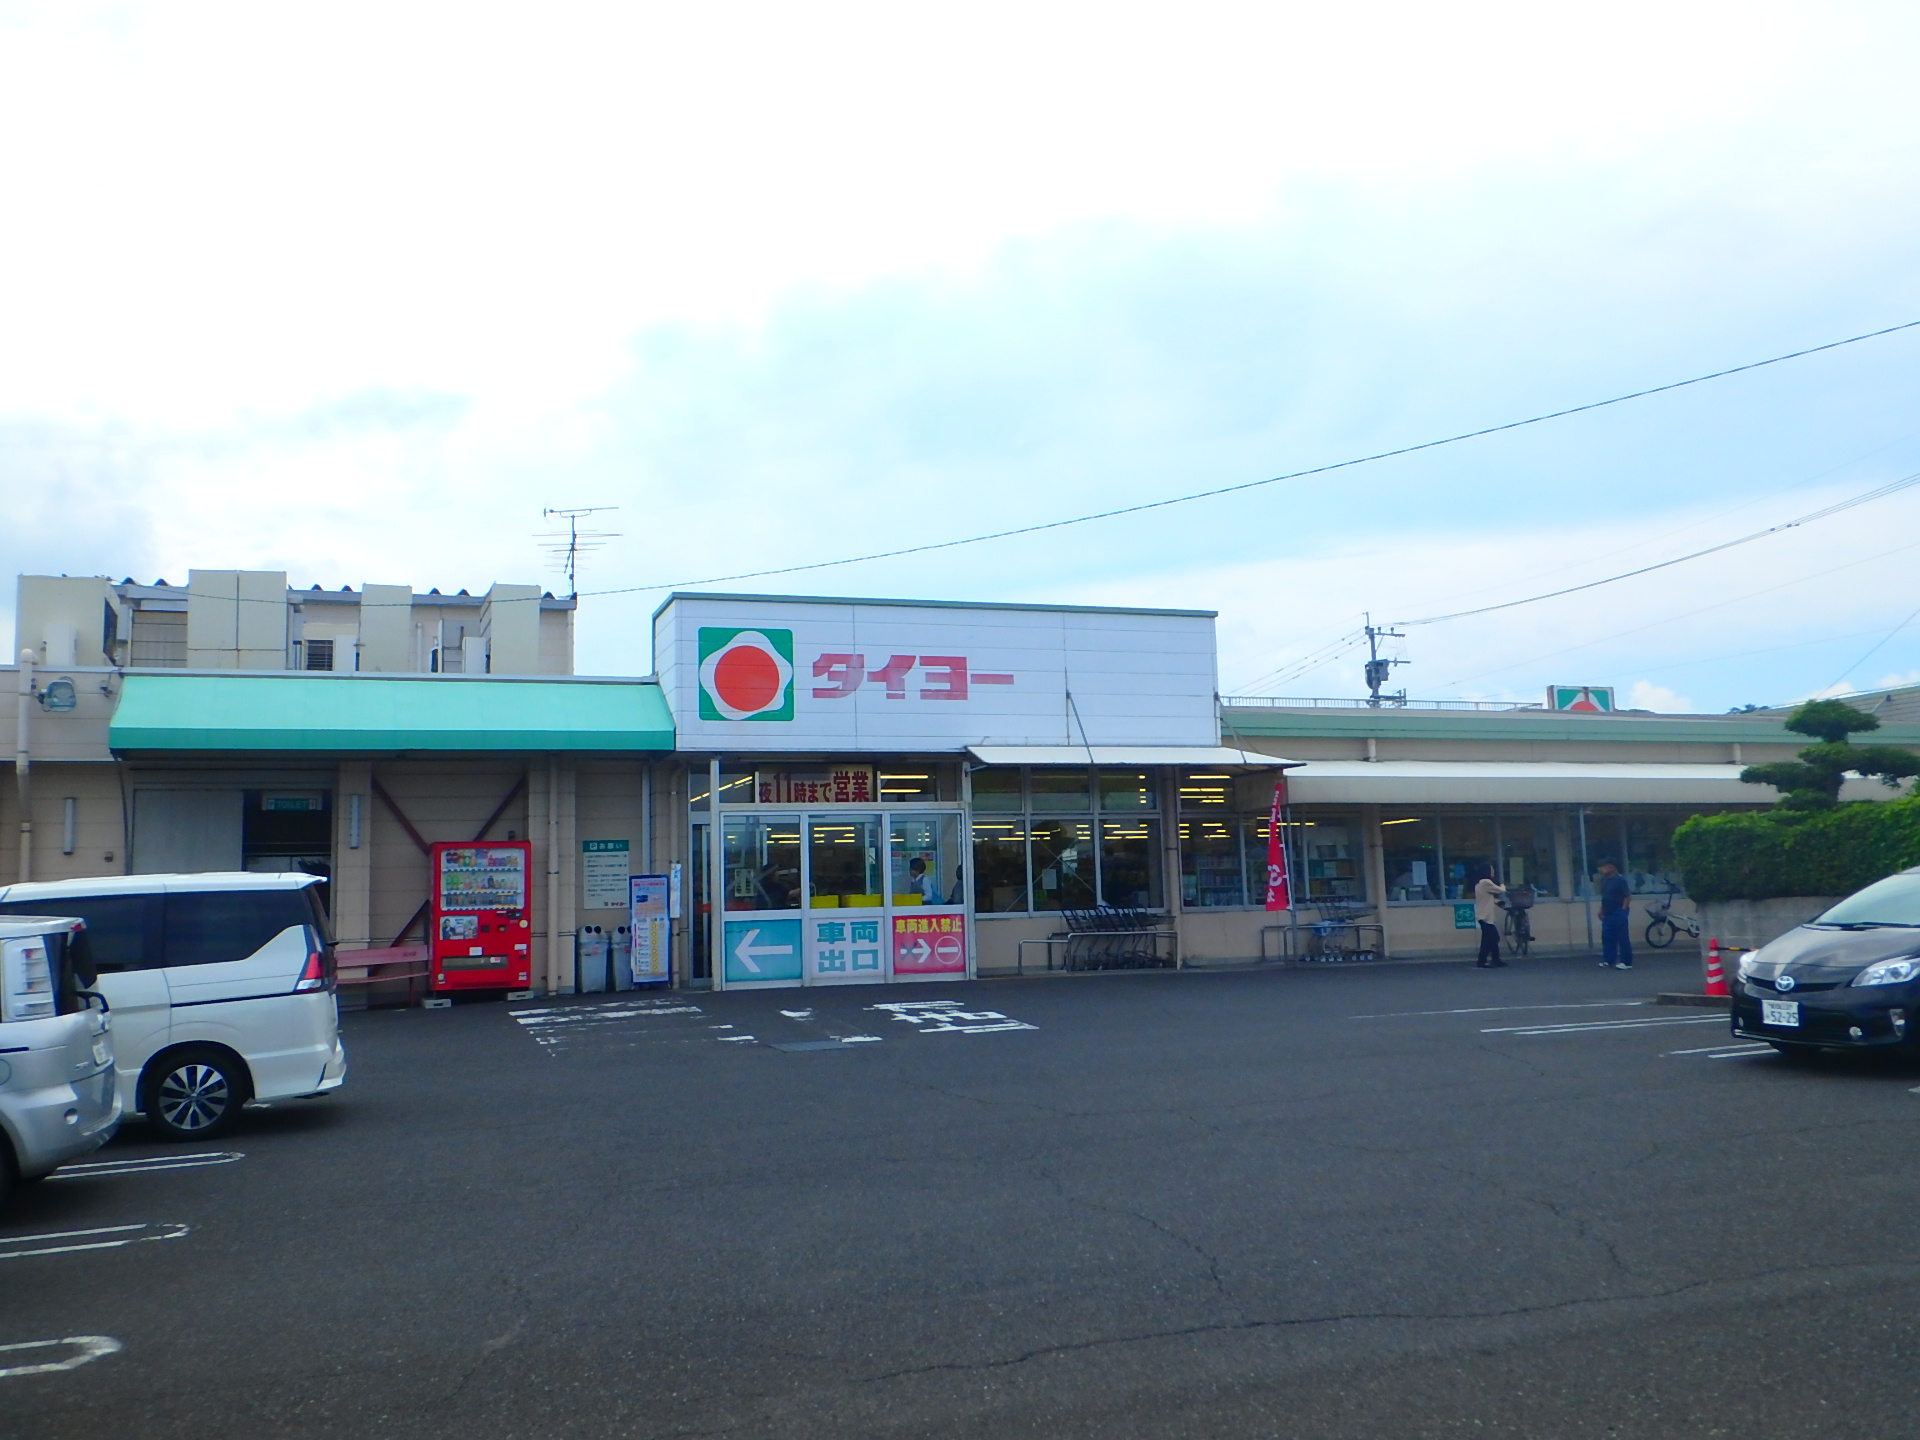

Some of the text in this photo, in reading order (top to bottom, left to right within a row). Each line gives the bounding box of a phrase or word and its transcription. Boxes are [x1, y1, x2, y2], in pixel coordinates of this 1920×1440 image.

[813, 653, 1015, 701] タイヨー
[759, 770, 870, 803] 夜11時まで営業
[276, 800, 308, 810] TOILET
[816, 920, 879, 945] 車両
[895, 918, 963, 934] 車両進入禁止
[818, 949, 879, 973] 出口
